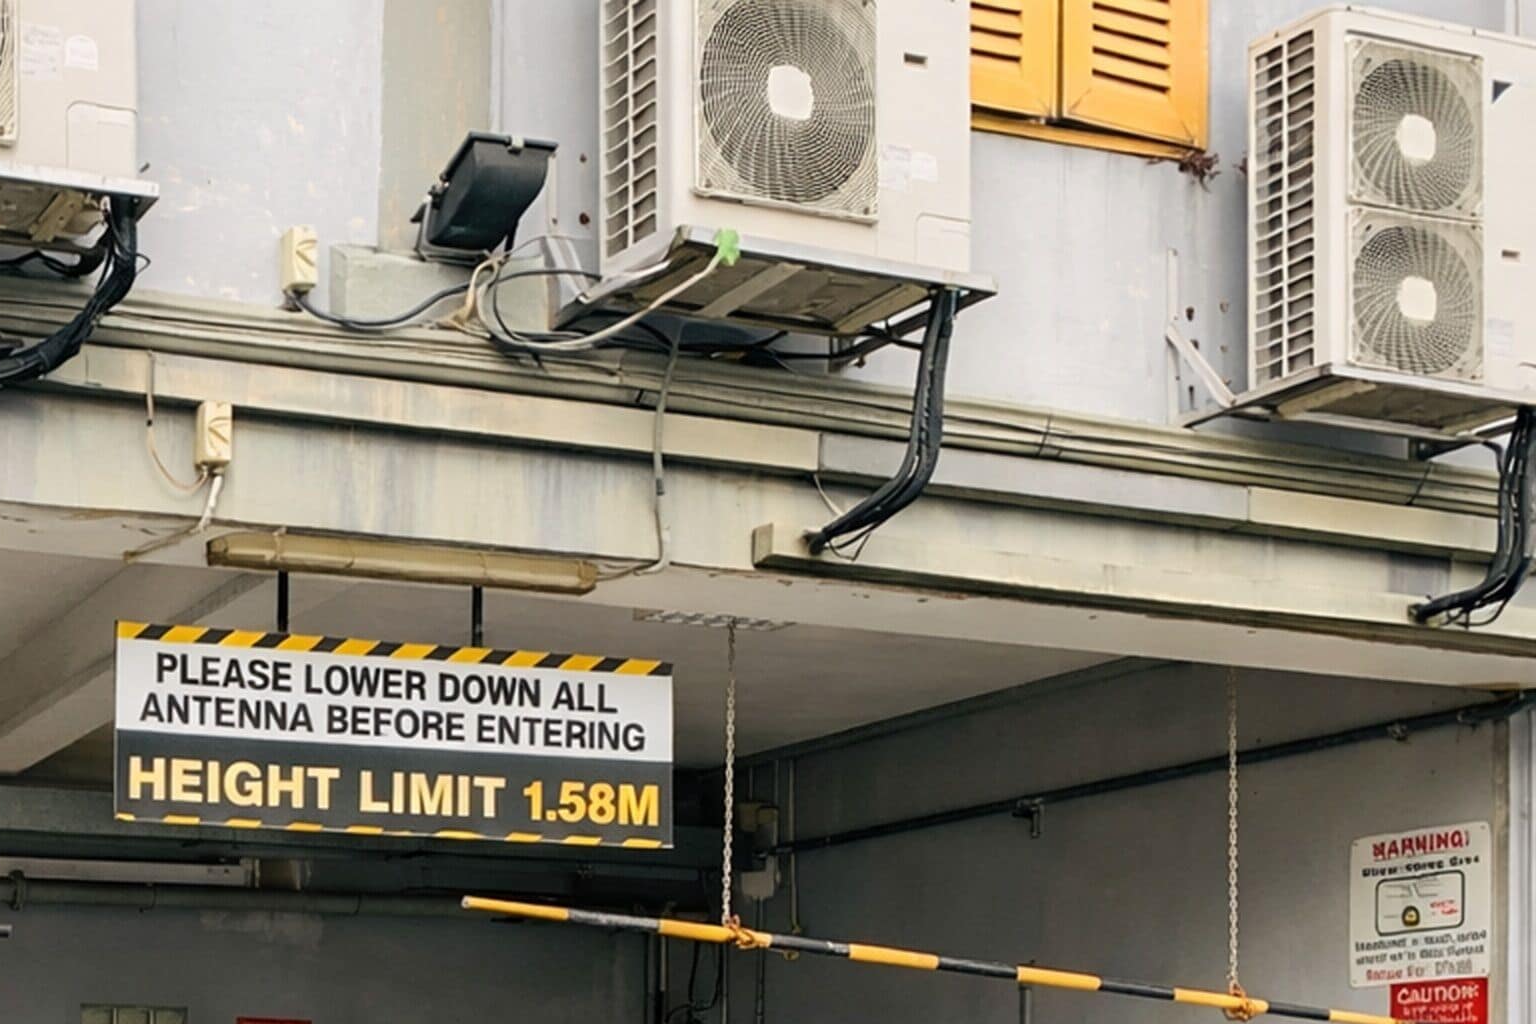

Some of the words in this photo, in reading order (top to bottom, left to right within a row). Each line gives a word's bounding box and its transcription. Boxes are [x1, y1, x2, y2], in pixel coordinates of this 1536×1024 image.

[156, 652, 292, 692] PLEASE
[305, 664, 426, 701] LOWER
[438, 672, 541, 708] DOWN
[551, 682, 618, 714] ALL
[140, 692, 313, 733] ANTENNA
[327, 704, 465, 742] BEFORE
[477, 714, 645, 752] ENTERING
[128, 755, 340, 811] HEIGHT
[359, 769, 506, 819] LIMIT
[523, 780, 660, 827] 1.58M
